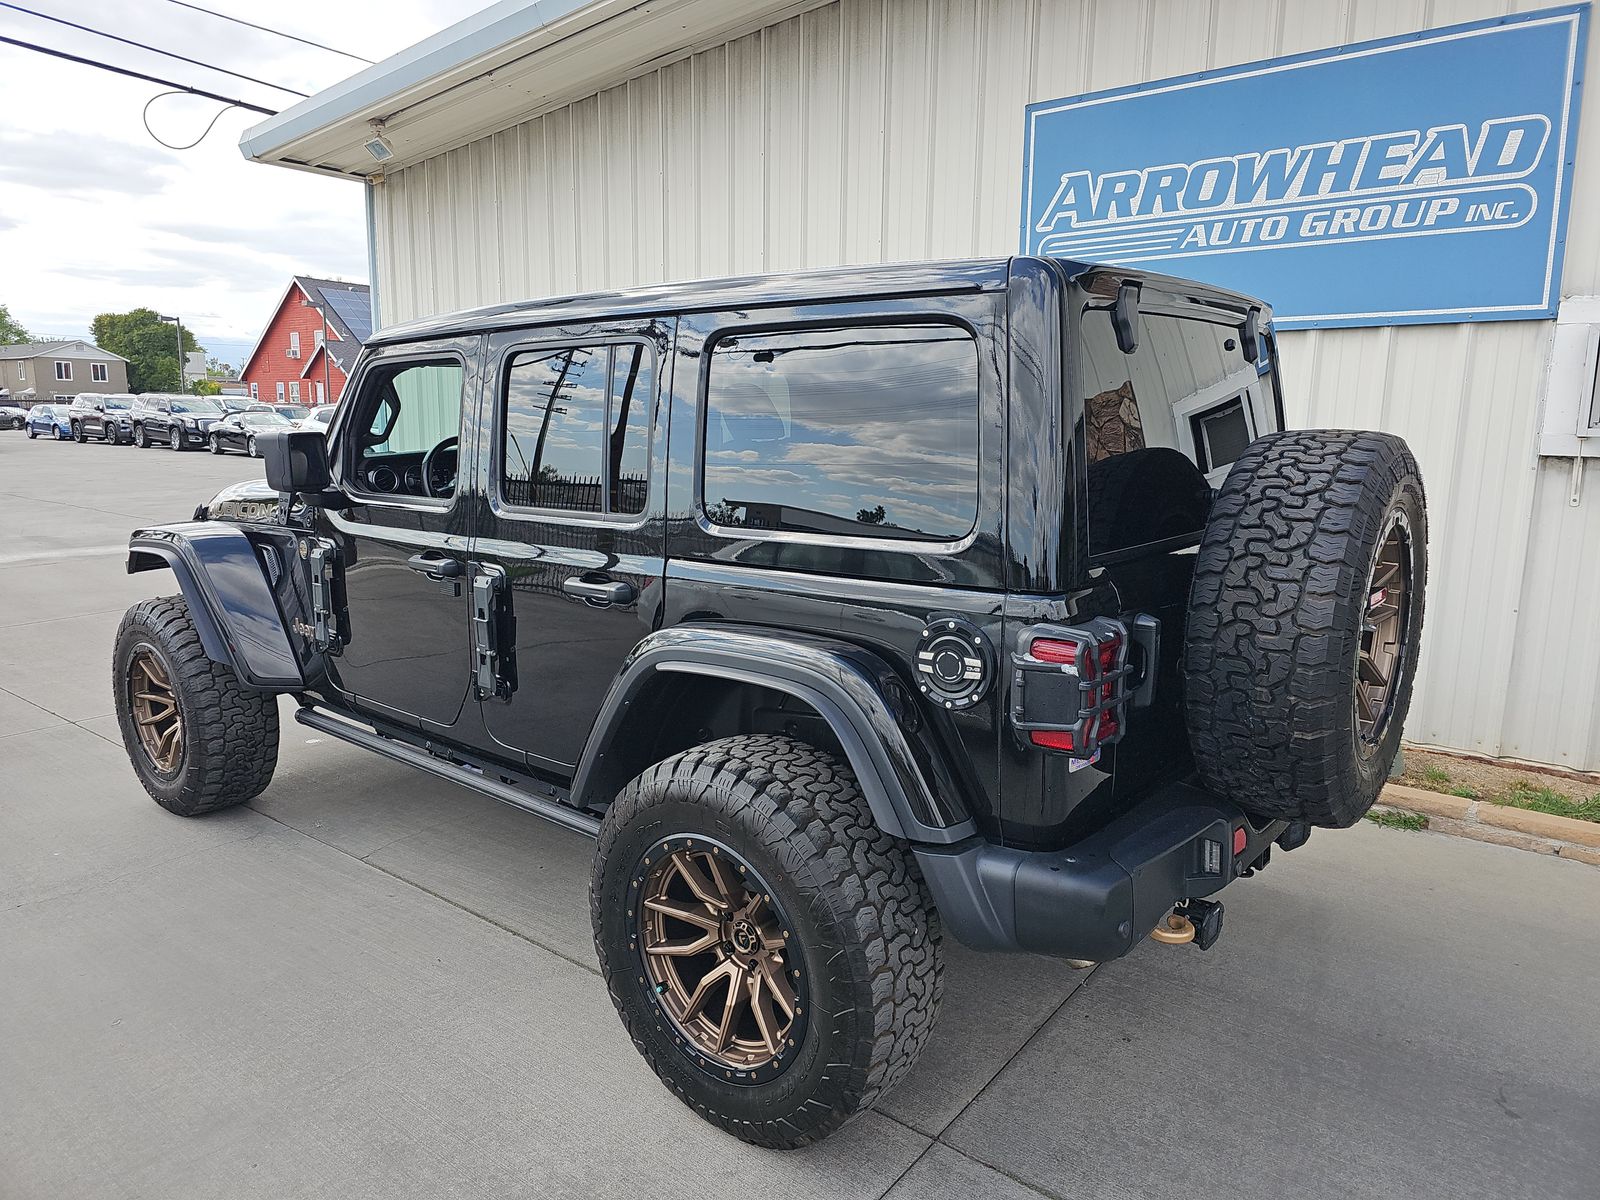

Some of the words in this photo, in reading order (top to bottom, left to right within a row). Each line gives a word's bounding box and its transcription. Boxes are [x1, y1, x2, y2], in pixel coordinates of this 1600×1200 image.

[1036, 113, 1552, 231] ARROWHEAD
[1179, 215, 1290, 249] AUTO
[1299, 197, 1460, 237] GROUP
[1464, 201, 1520, 223] INC.
